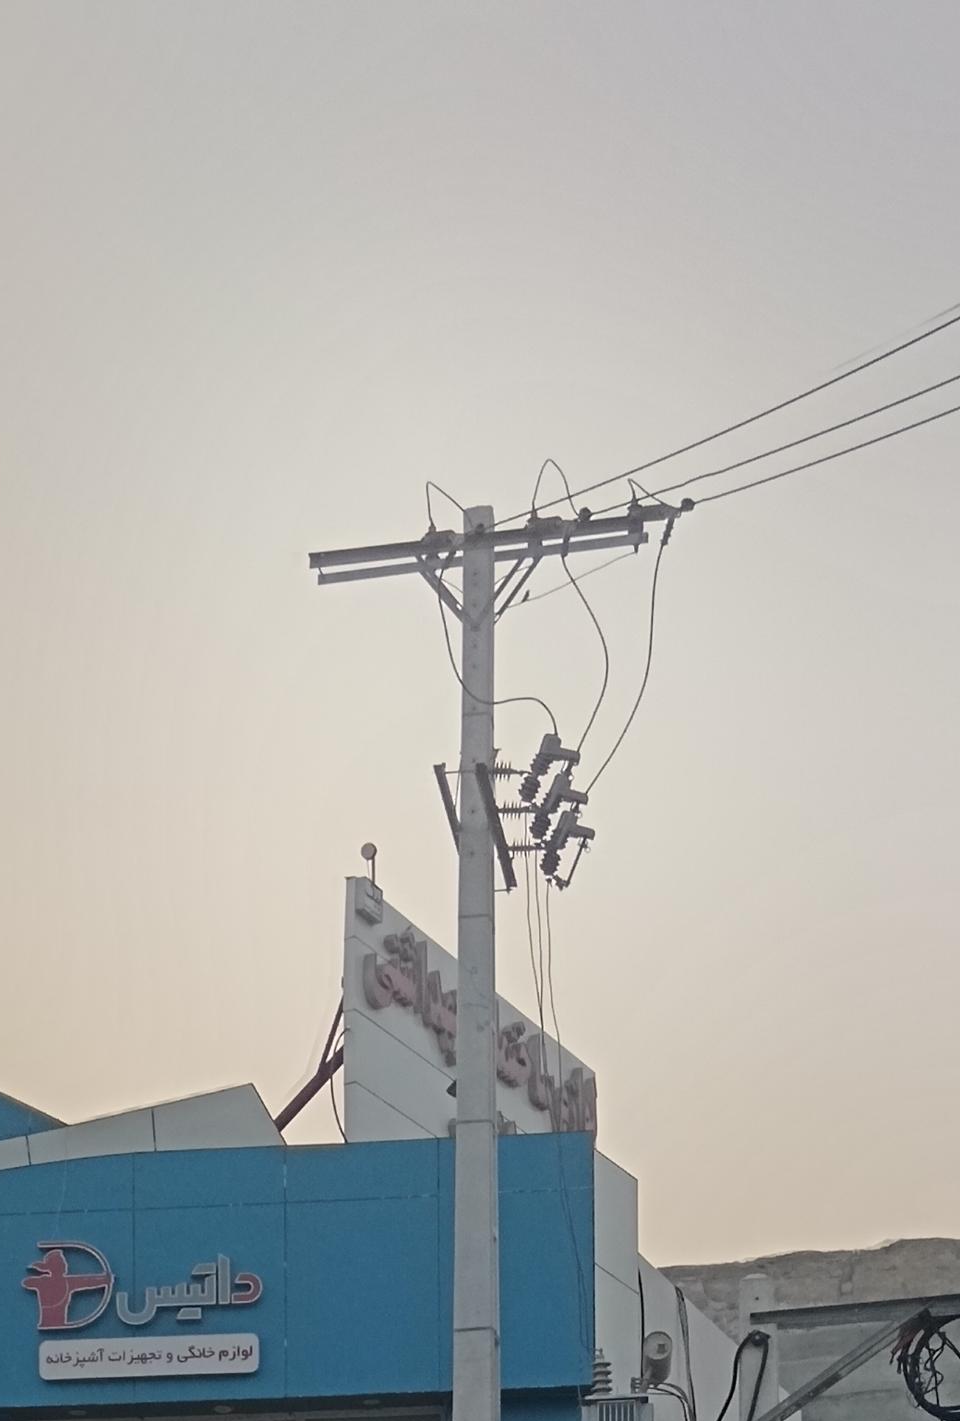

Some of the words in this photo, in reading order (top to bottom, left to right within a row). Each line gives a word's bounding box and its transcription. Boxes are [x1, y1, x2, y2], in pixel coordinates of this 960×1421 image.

[116, 1253, 263, 1325] داتیس
[45, 1347, 105, 1369] آشپزخانه
[107, 1349, 162, 1366] تجهیزات
[166, 1354, 174, 1364] و
[176, 1345, 216, 1363] خانگی
[218, 1345, 254, 1362] لوازم
